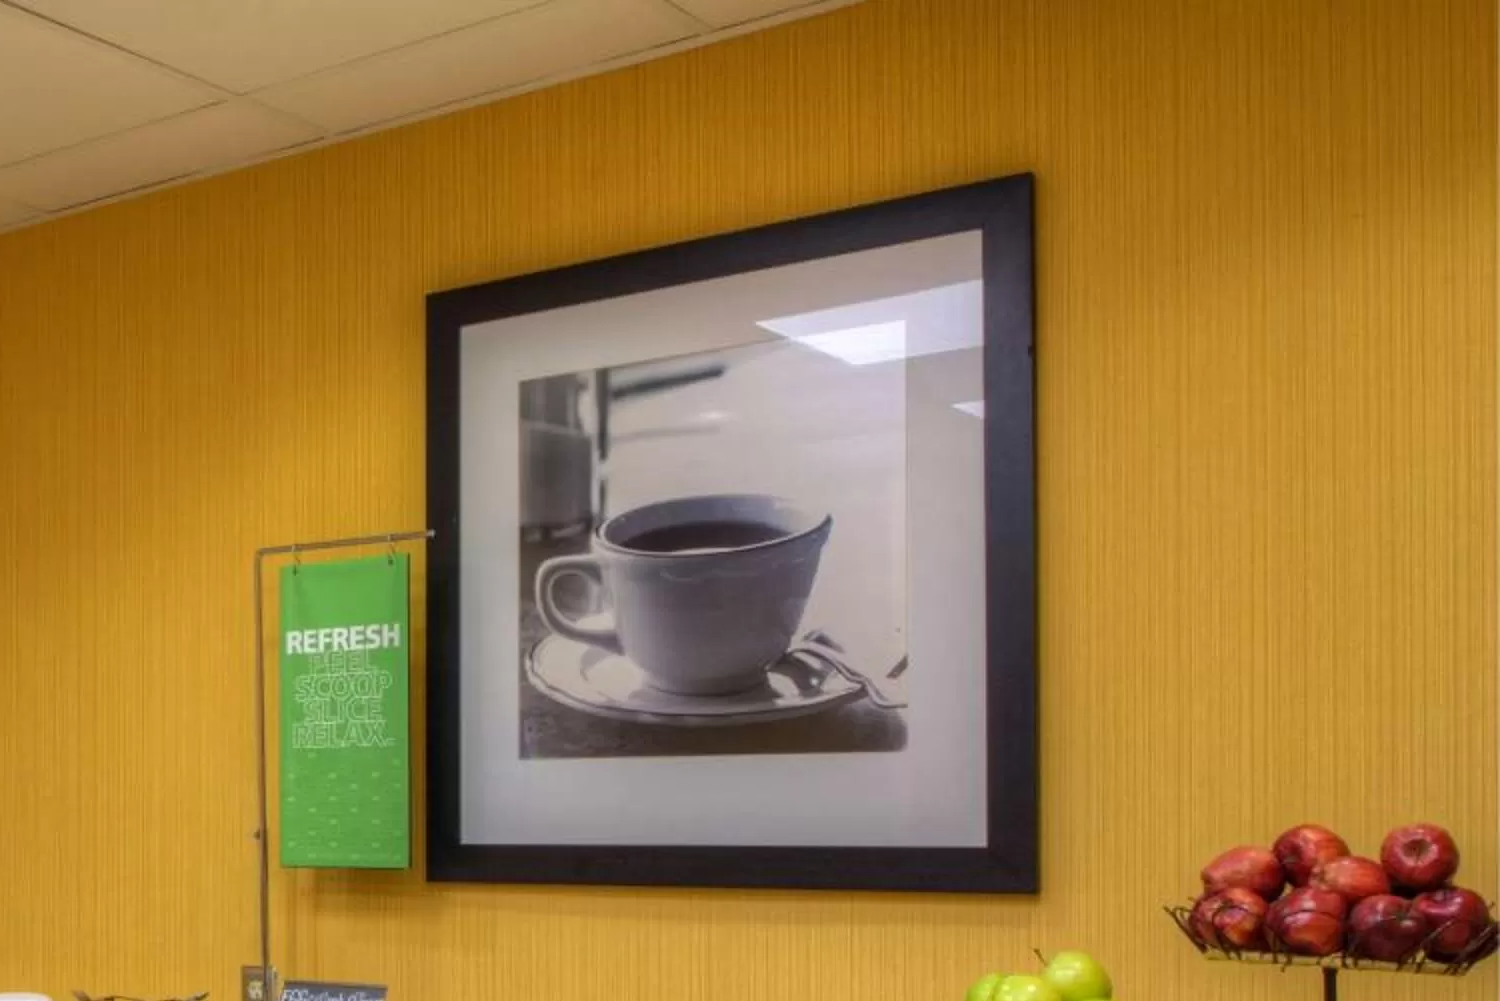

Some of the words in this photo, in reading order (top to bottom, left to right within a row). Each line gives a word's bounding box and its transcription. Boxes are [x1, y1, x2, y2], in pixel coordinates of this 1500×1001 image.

[285, 623, 401, 655] REFRESH
[294, 668, 393, 702] SCOOP
[302, 696, 386, 724] SLICE
